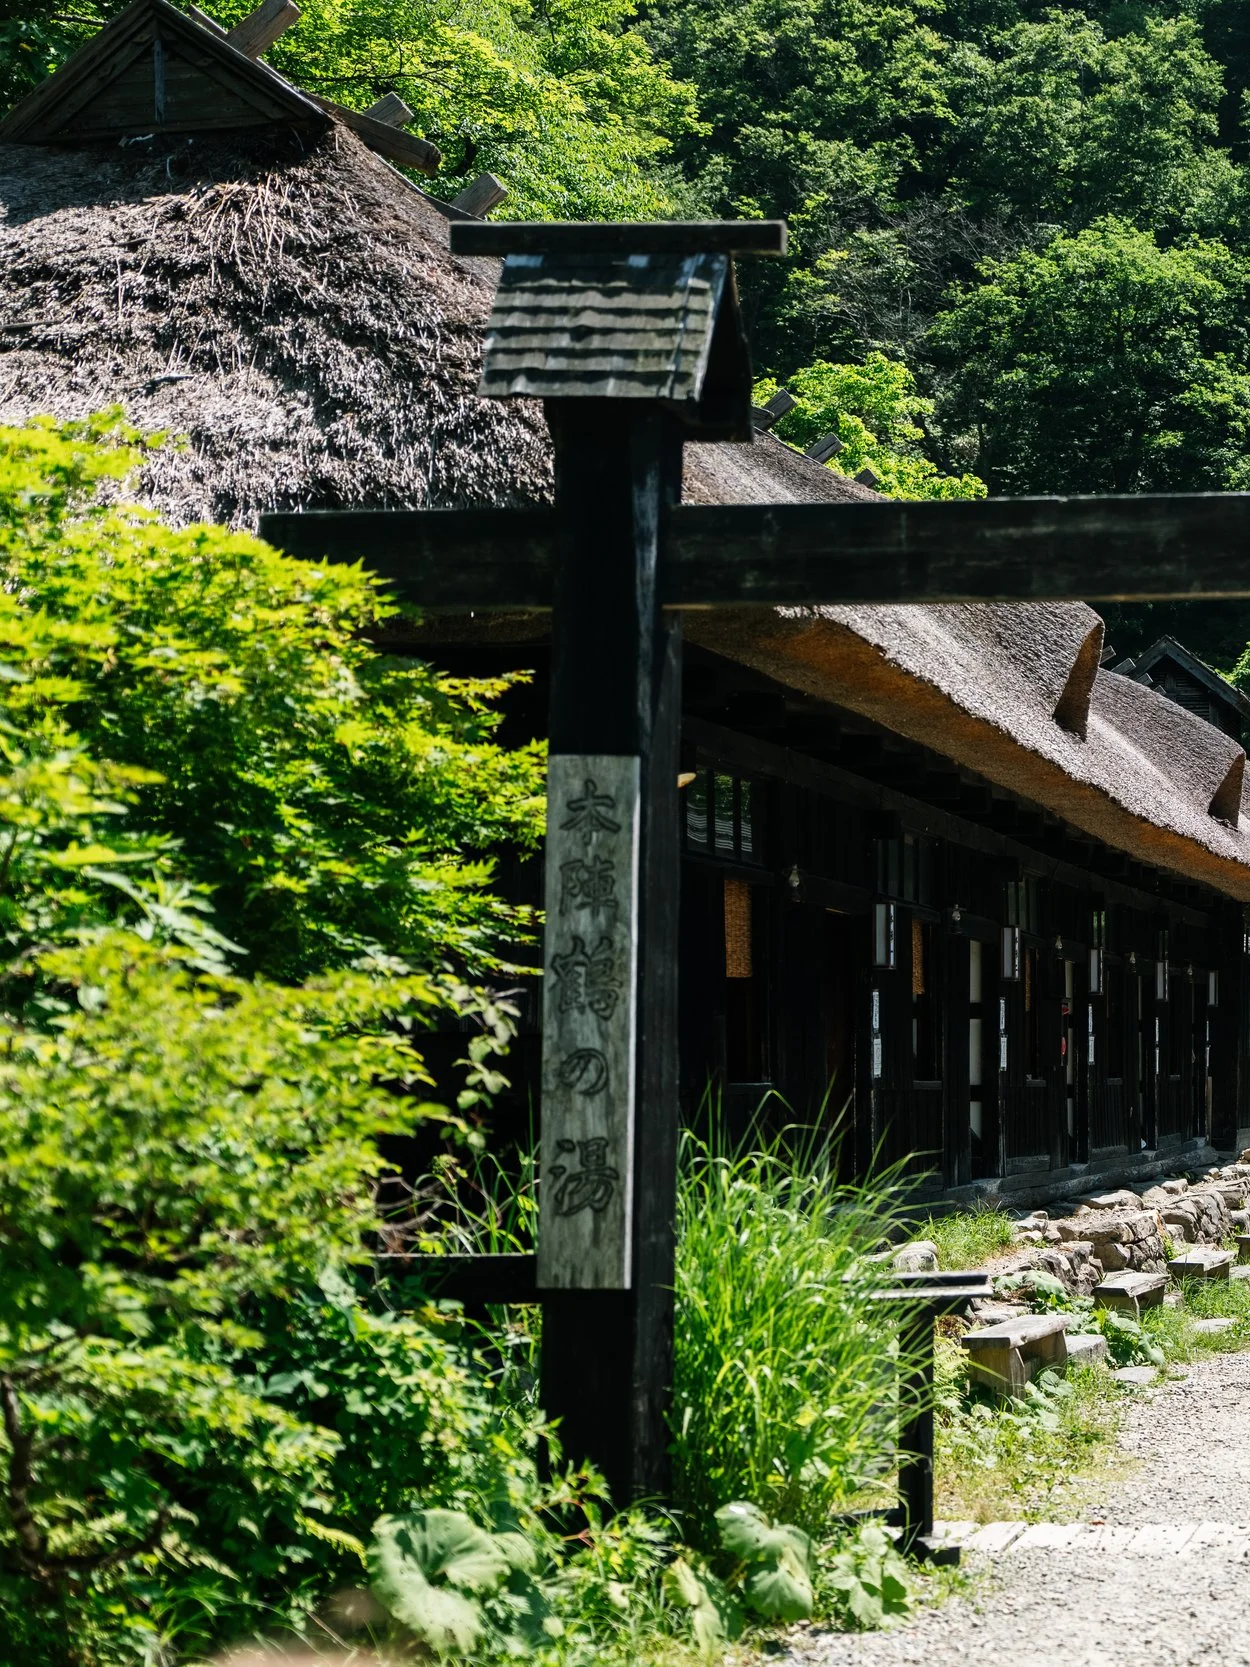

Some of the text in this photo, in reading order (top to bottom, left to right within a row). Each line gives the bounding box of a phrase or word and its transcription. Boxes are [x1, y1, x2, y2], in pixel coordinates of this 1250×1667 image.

[549, 778, 623, 1217] 本陣鶴の湯
